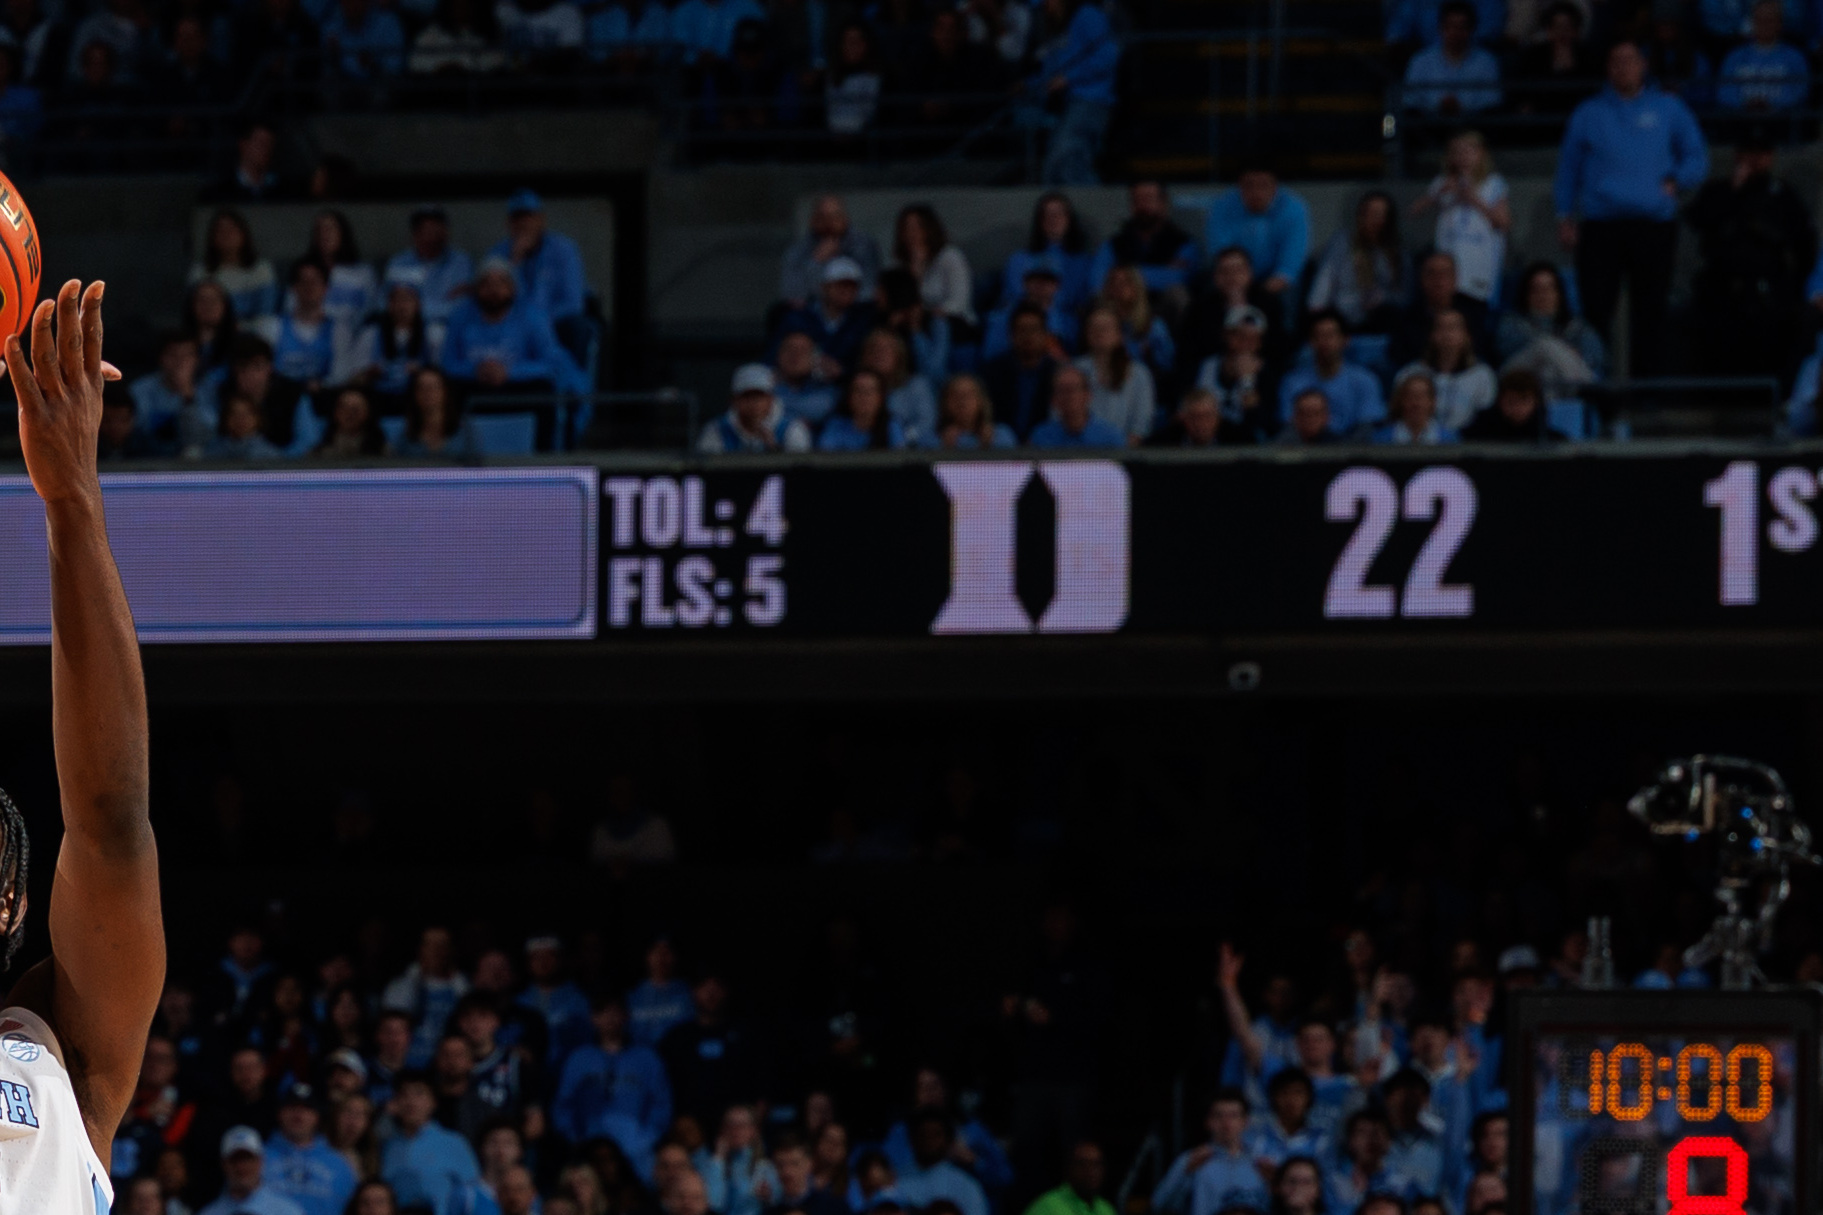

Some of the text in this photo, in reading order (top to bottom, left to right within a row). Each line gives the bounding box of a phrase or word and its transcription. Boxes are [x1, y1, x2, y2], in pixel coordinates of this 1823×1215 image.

[605, 475, 788, 548] TOL: 4
[1323, 465, 1478, 619] 22
[1703, 460, 1823, 606] 1S
[608, 555, 787, 627] FLS: 5
[1589, 1043, 1773, 1122] 10:00
